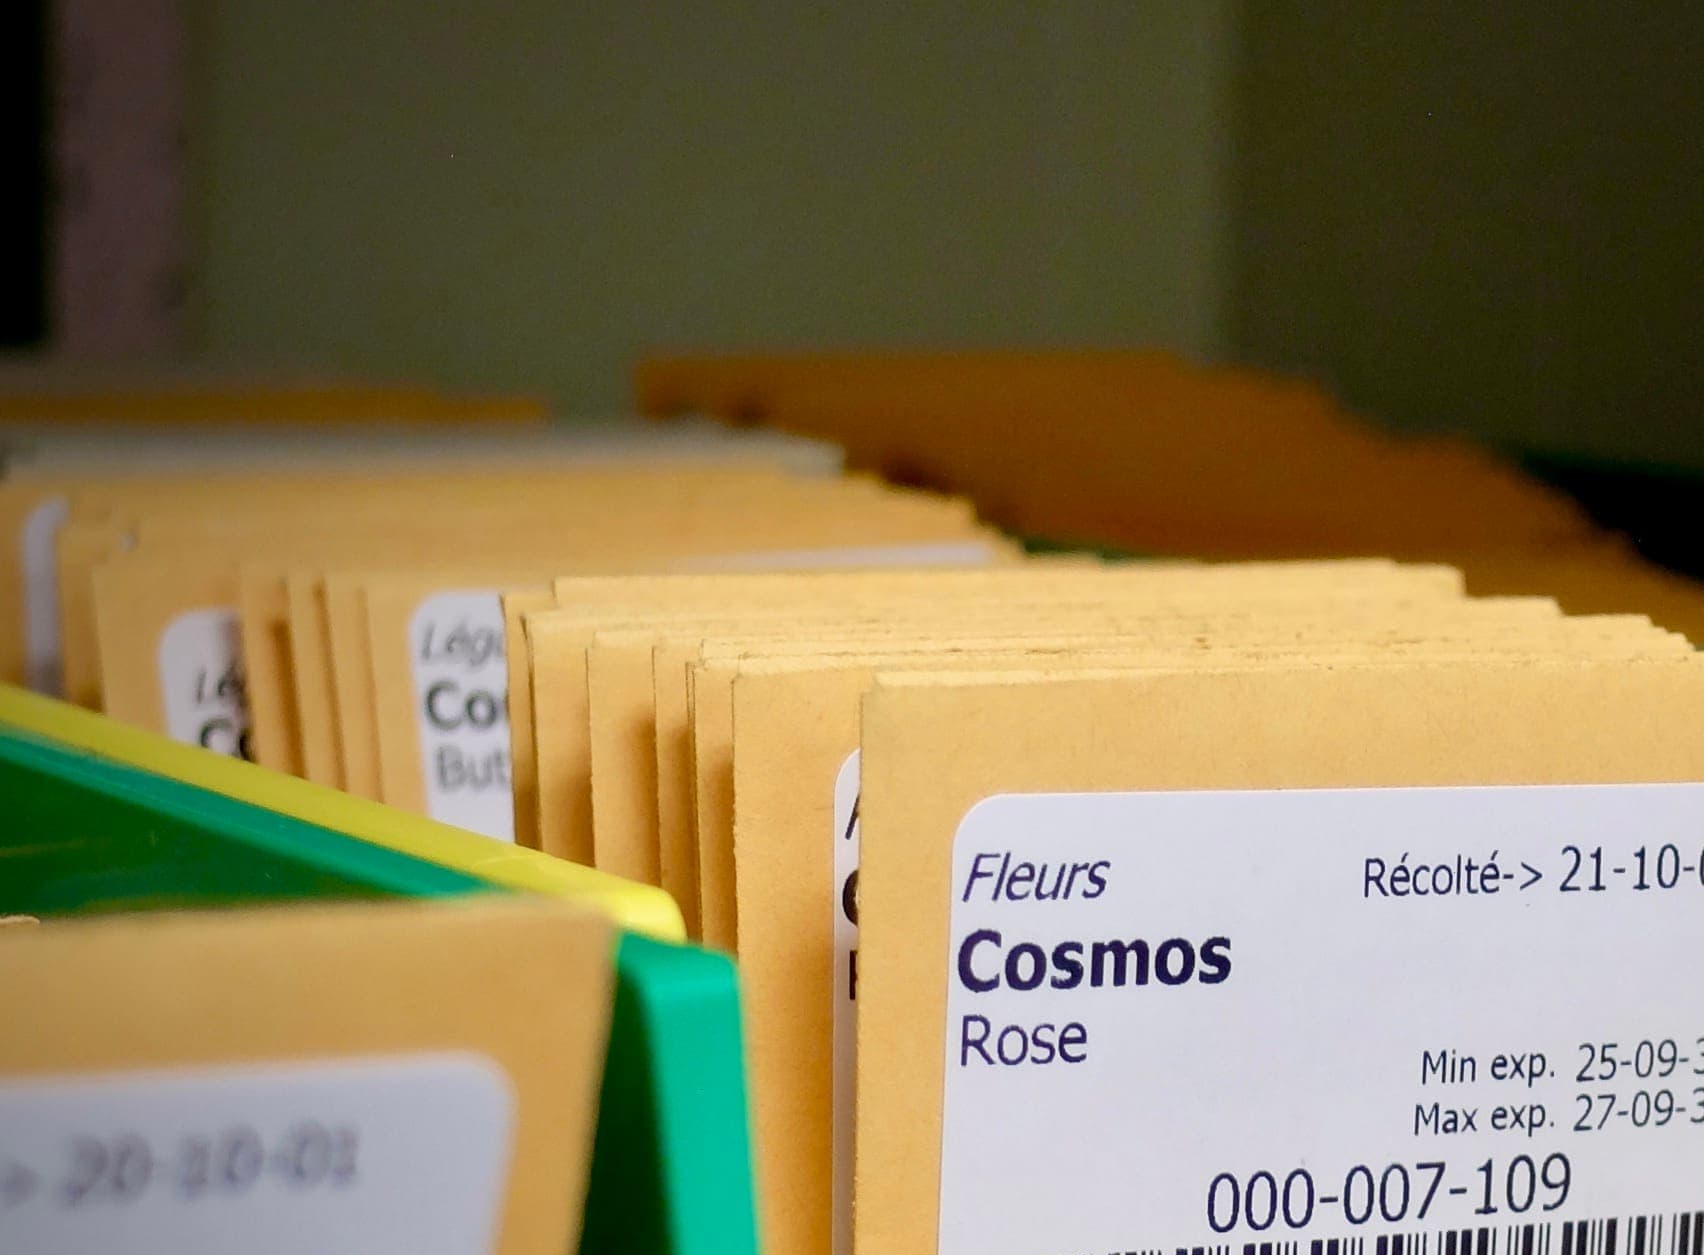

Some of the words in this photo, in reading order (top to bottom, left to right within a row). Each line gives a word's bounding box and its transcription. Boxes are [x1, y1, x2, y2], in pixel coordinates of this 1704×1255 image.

[961, 851, 1111, 904] Fleurs
[957, 928, 1232, 994] Cosmos
[960, 1014, 1088, 1067] Rose
[1421, 1049, 1477, 1086] Min
[1490, 1053, 1555, 1088] exp.
[1414, 1102, 1478, 1136] Max
[1490, 1105, 1554, 1139] exp.
[1206, 1152, 1572, 1233] 000-007-109
